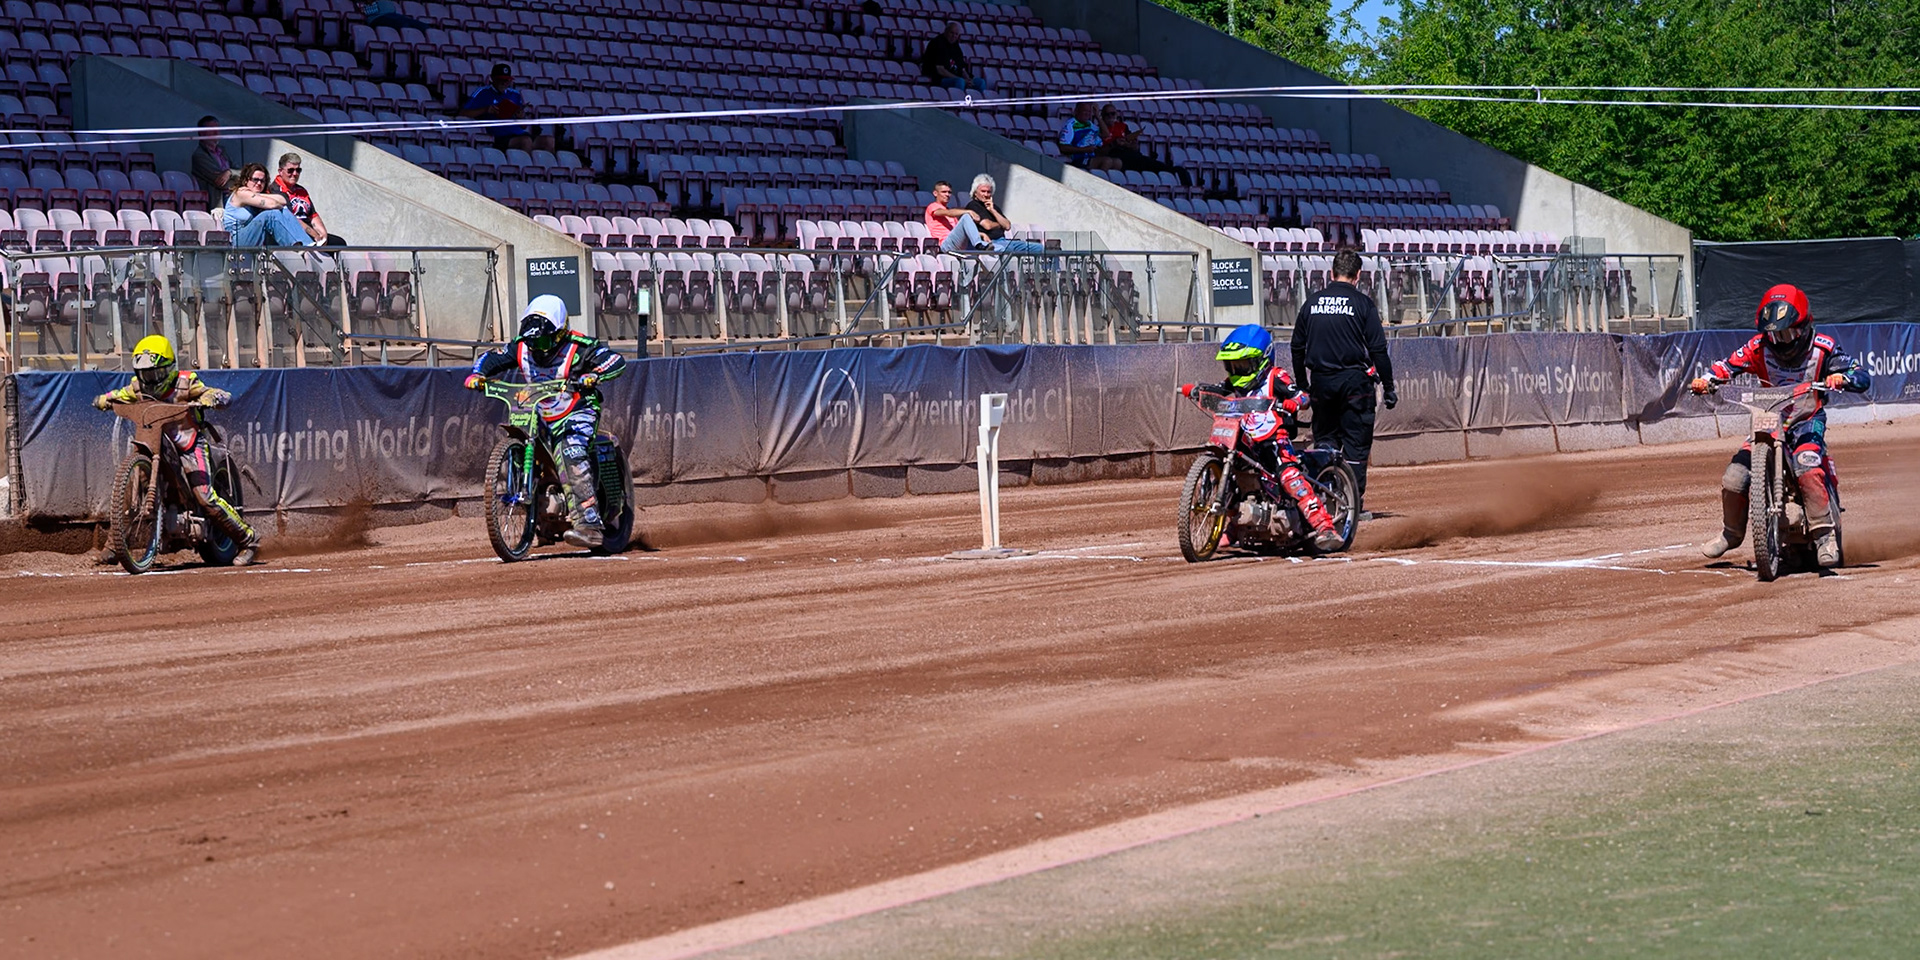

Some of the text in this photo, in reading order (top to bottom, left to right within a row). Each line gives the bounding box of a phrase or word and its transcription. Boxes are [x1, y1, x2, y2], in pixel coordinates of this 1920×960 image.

[530, 261, 566, 271] BLOCK E
[1236, 261, 1241, 269] F
[1236, 278, 1242, 286] G
[1318, 297, 1349, 306] START
[1311, 305, 1354, 316] MARSHAL
[1511, 366, 1551, 395] Travel
[1554, 364, 1614, 394] Solutions
[356, 415, 434, 459] World
